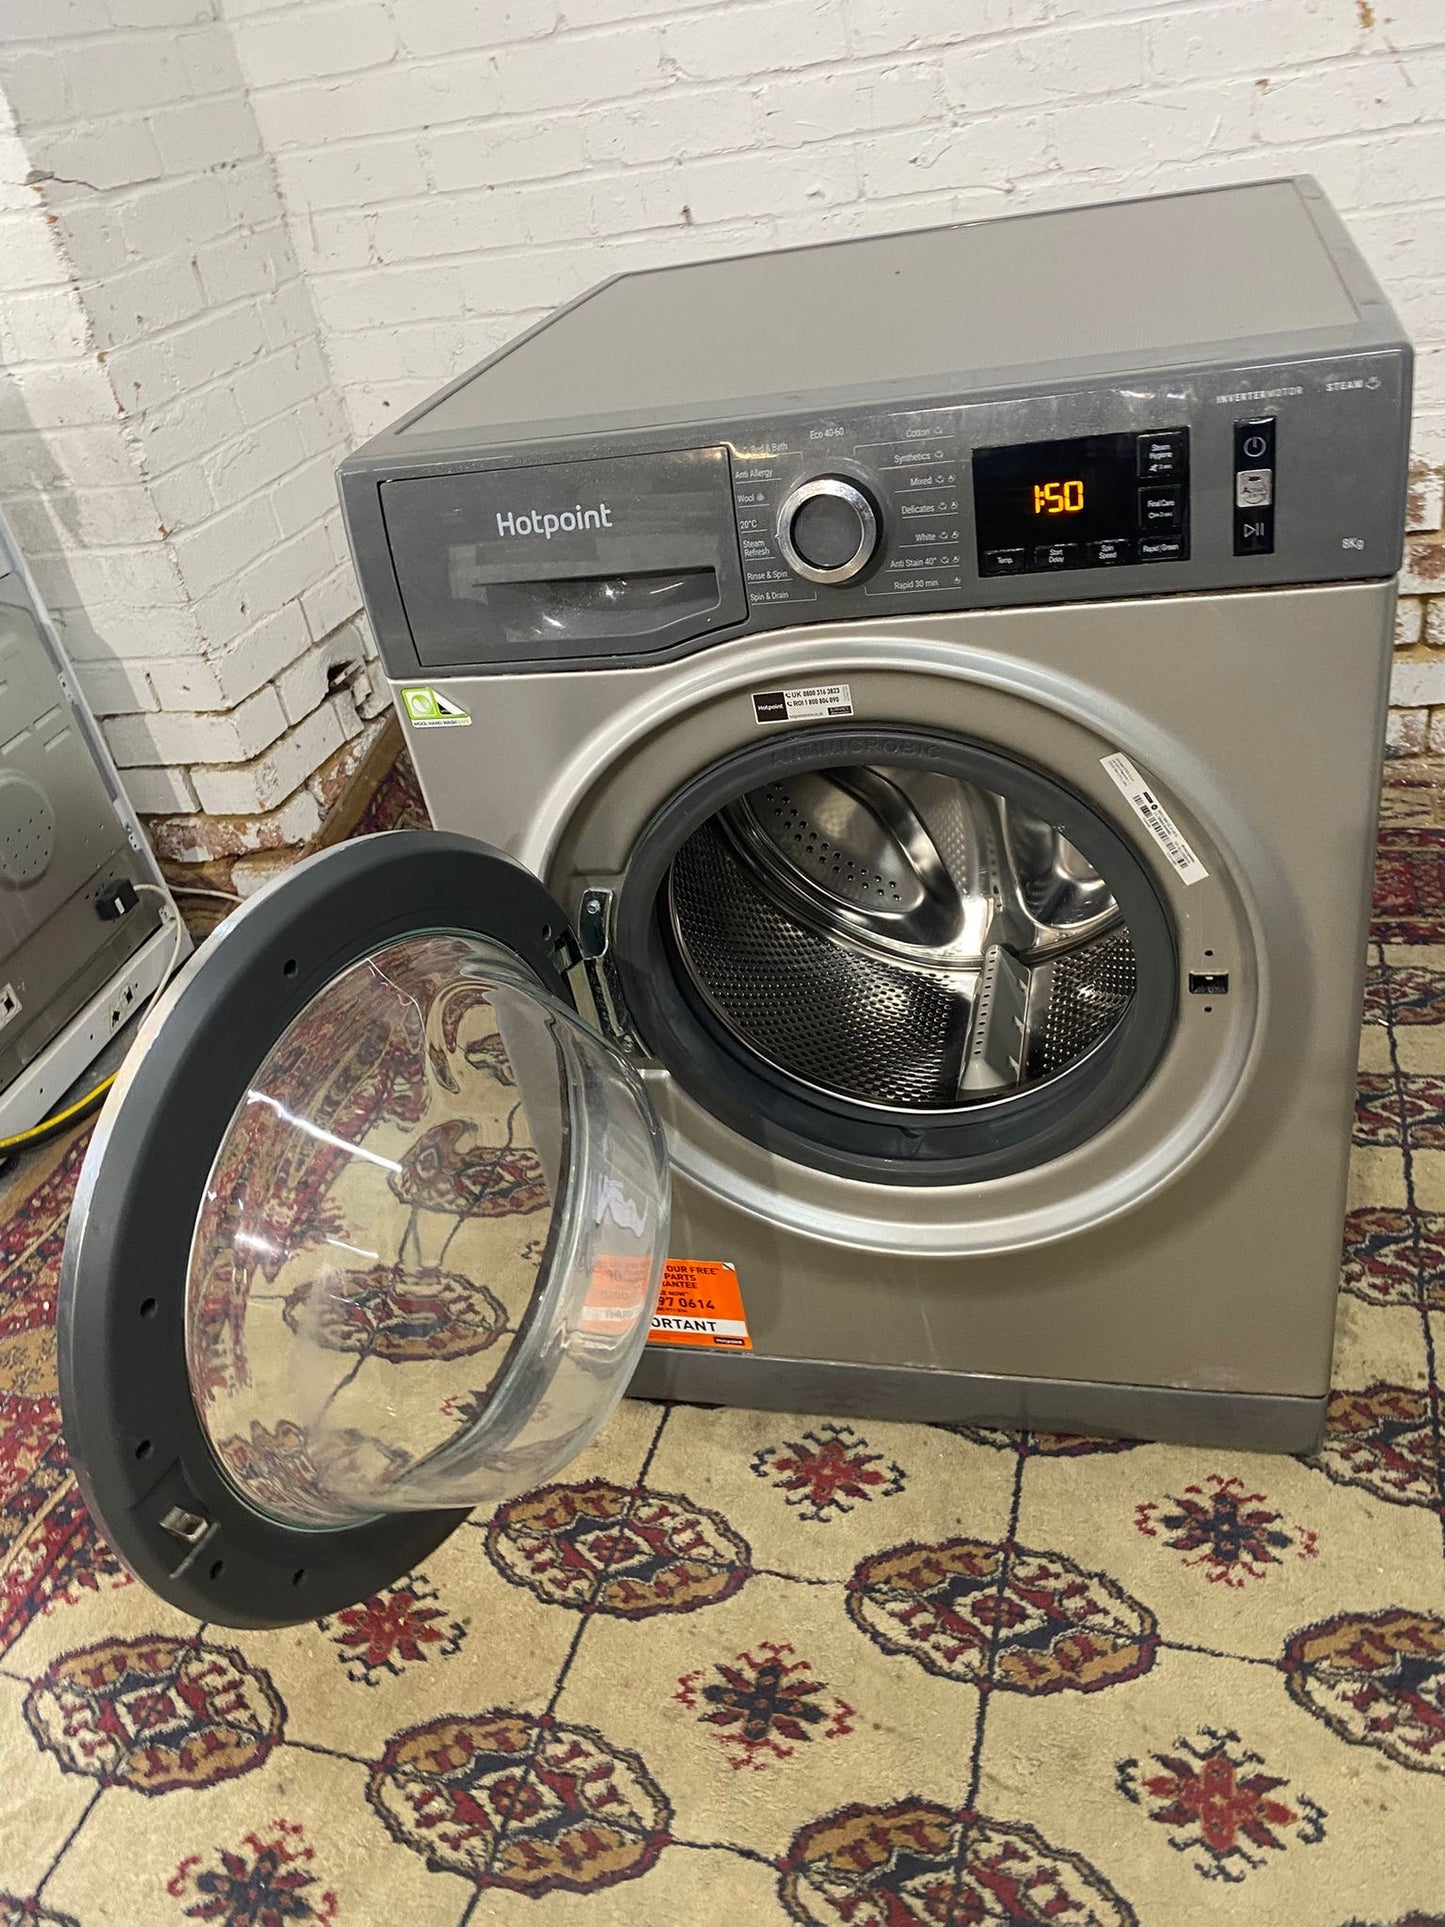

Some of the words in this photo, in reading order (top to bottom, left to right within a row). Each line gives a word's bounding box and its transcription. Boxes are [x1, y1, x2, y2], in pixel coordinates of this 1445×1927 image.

[1326, 379, 1364, 392] STEAM
[810, 430, 823, 440] Eco
[824, 427, 845, 437] 40-60
[906, 428, 930, 438] Cotton
[894, 452, 931, 465] Synthetics
[735, 470, 749, 479] Anti
[750, 468, 773, 479] Allergy
[910, 475, 933, 486] Mixed
[737, 493, 755, 503] Wool
[1034, 480, 1084, 514] 1:50
[901, 504, 935, 515] Delicates
[496, 503, 613, 539] Hotpoint
[915, 533, 936, 542] White
[743, 540, 765, 549] Steam
[744, 547, 770, 557] Refresh
[891, 560, 904, 568] Anti
[905, 558, 924, 567] Stain
[747, 571, 766, 581] Rinse
[772, 570, 788, 580] Spin
[894, 580, 914, 590] Rapid
[914, 579, 925, 588] 30
[925, 579, 939, 587] min
[750, 592, 764, 602] Spin
[771, 590, 789, 600] Drain
[757, 703, 784, 712] Hotpoint
[666, 1265, 688, 1273] OUR
[664, 1273, 697, 1282] PARTS
[679, 1298, 715, 1309] 0614
